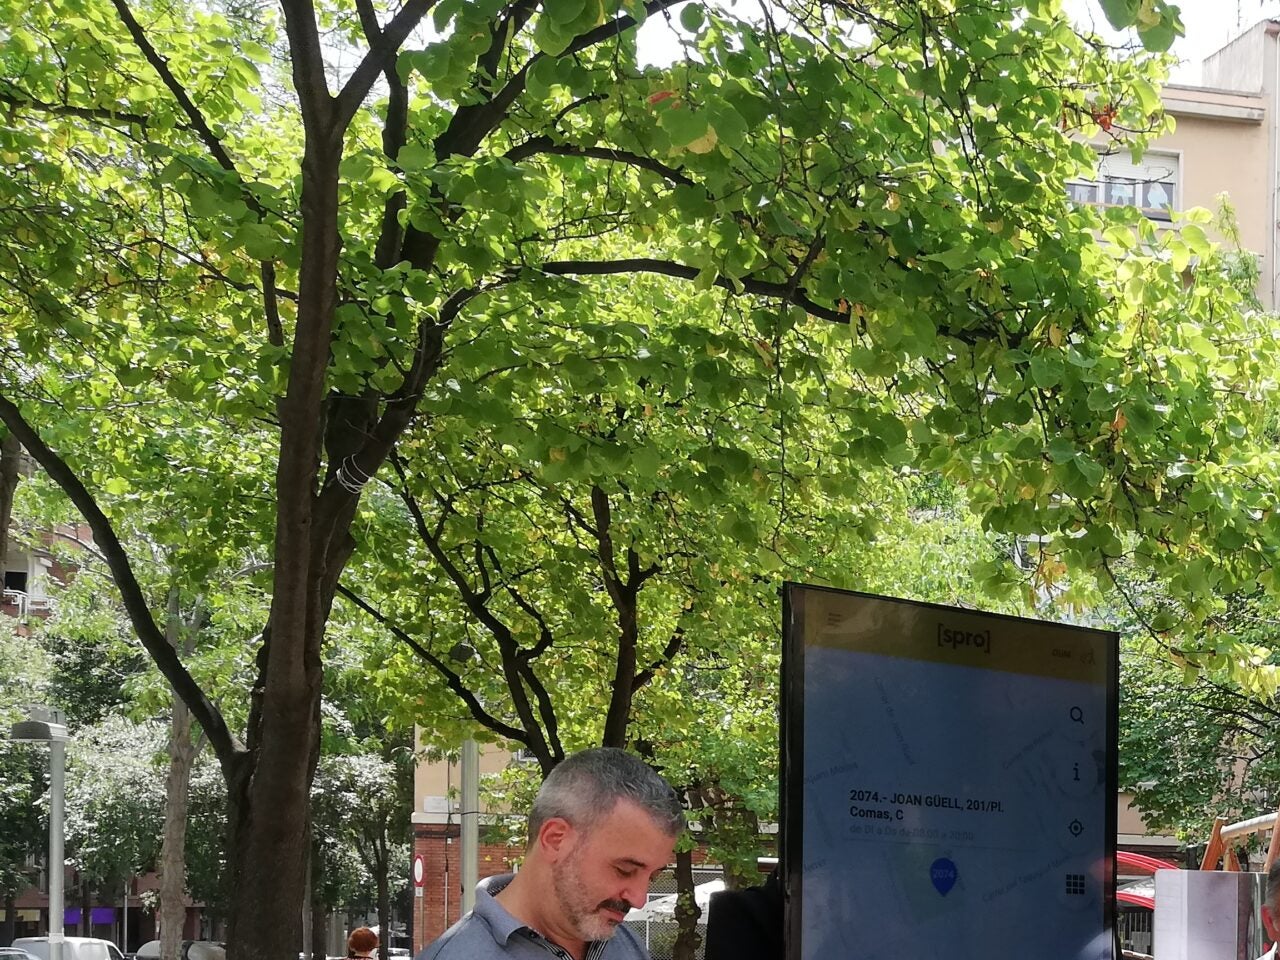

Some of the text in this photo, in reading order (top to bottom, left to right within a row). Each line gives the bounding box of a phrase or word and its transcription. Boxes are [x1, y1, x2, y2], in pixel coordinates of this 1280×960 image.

[890, 793, 922, 806] JOAN
[925, 793, 964, 811] GÜELL,
[850, 806, 904, 822] Comas, C
